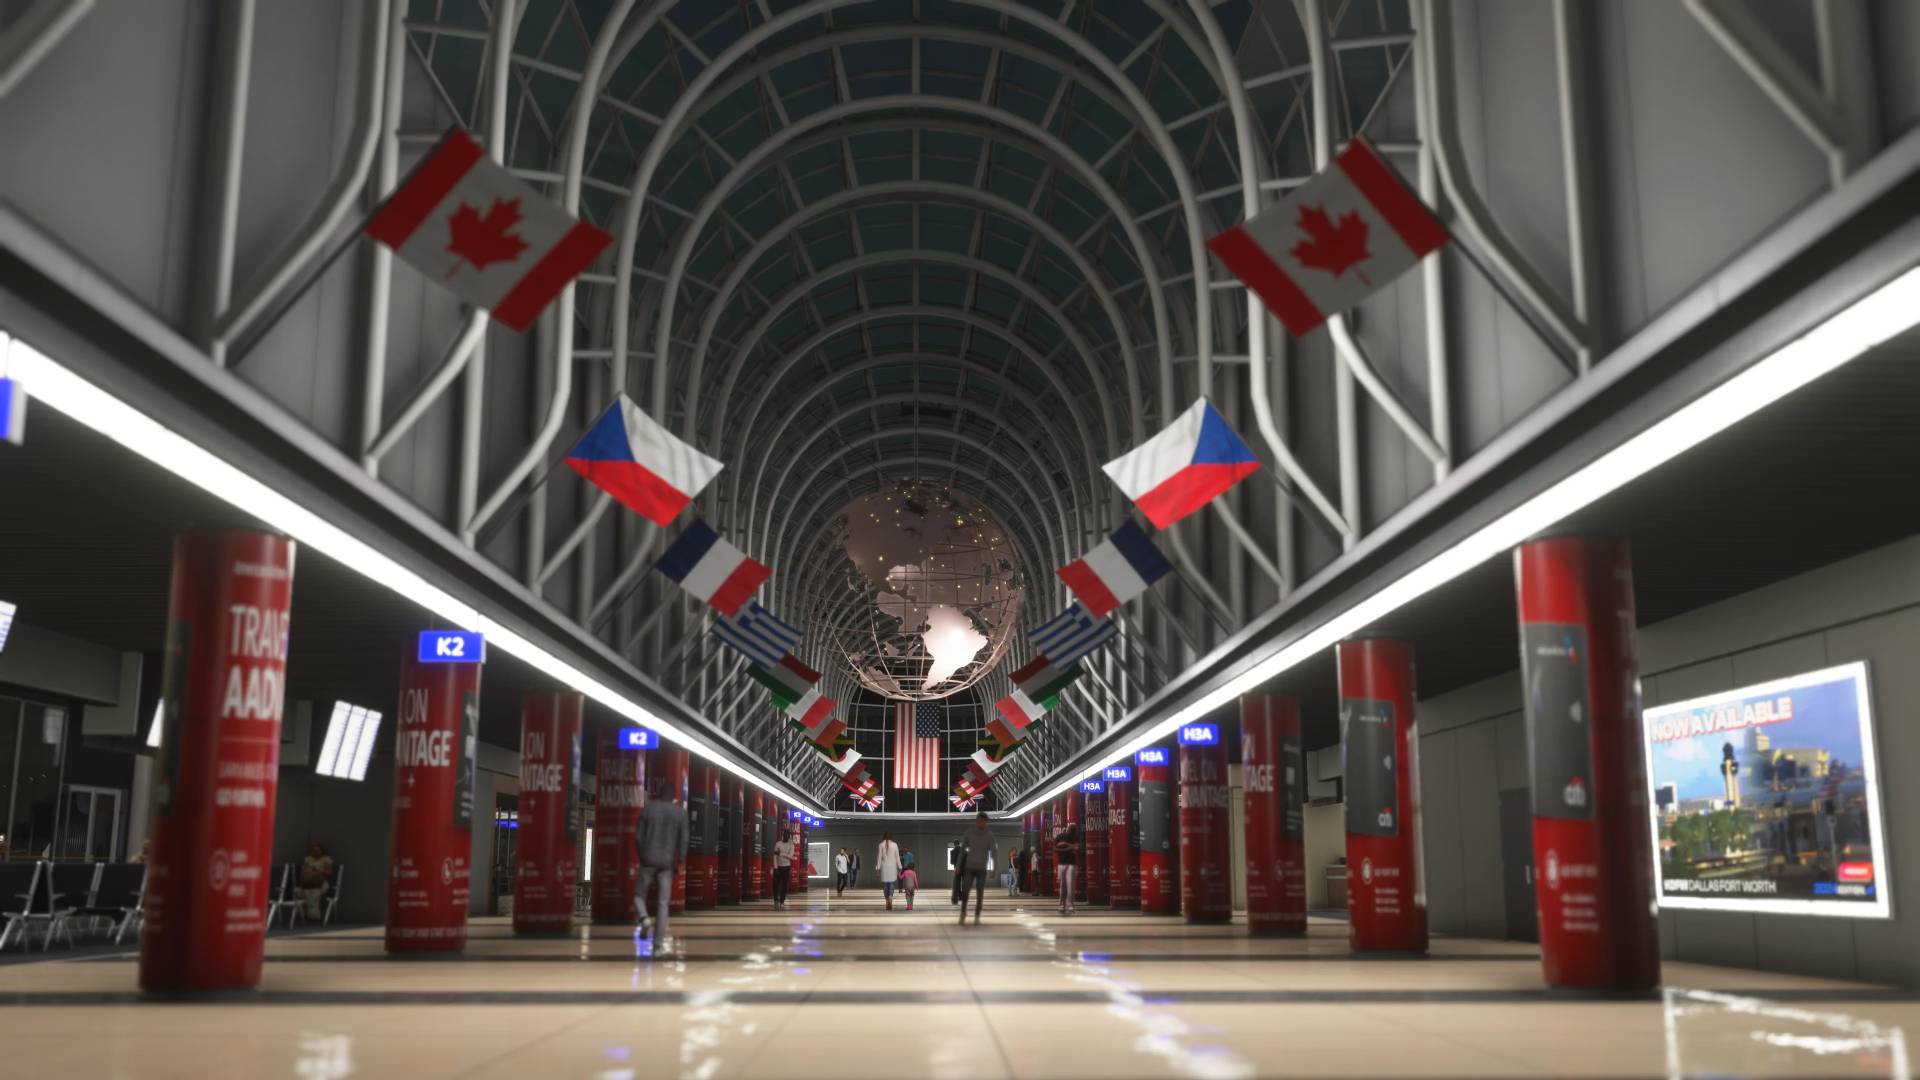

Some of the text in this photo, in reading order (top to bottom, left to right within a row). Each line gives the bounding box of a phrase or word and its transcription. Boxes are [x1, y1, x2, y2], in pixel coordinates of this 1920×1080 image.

[436, 636, 465, 657] K2
[1651, 696, 1793, 742] NOW AVAILABLE
[628, 731, 648, 746] K2
[1183, 727, 1213, 741] H3A
[395, 729, 453, 767] NTAGE
[1139, 751, 1164, 762] H3A
[520, 763, 563, 792] NTAGE
[1107, 769, 1126, 778] H3A
[1083, 782, 1101, 791] H3A
[1688, 880, 1718, 892] DALLAS
[1719, 880, 1741, 892] FORT
[1741, 880, 1777, 893] WORTH
